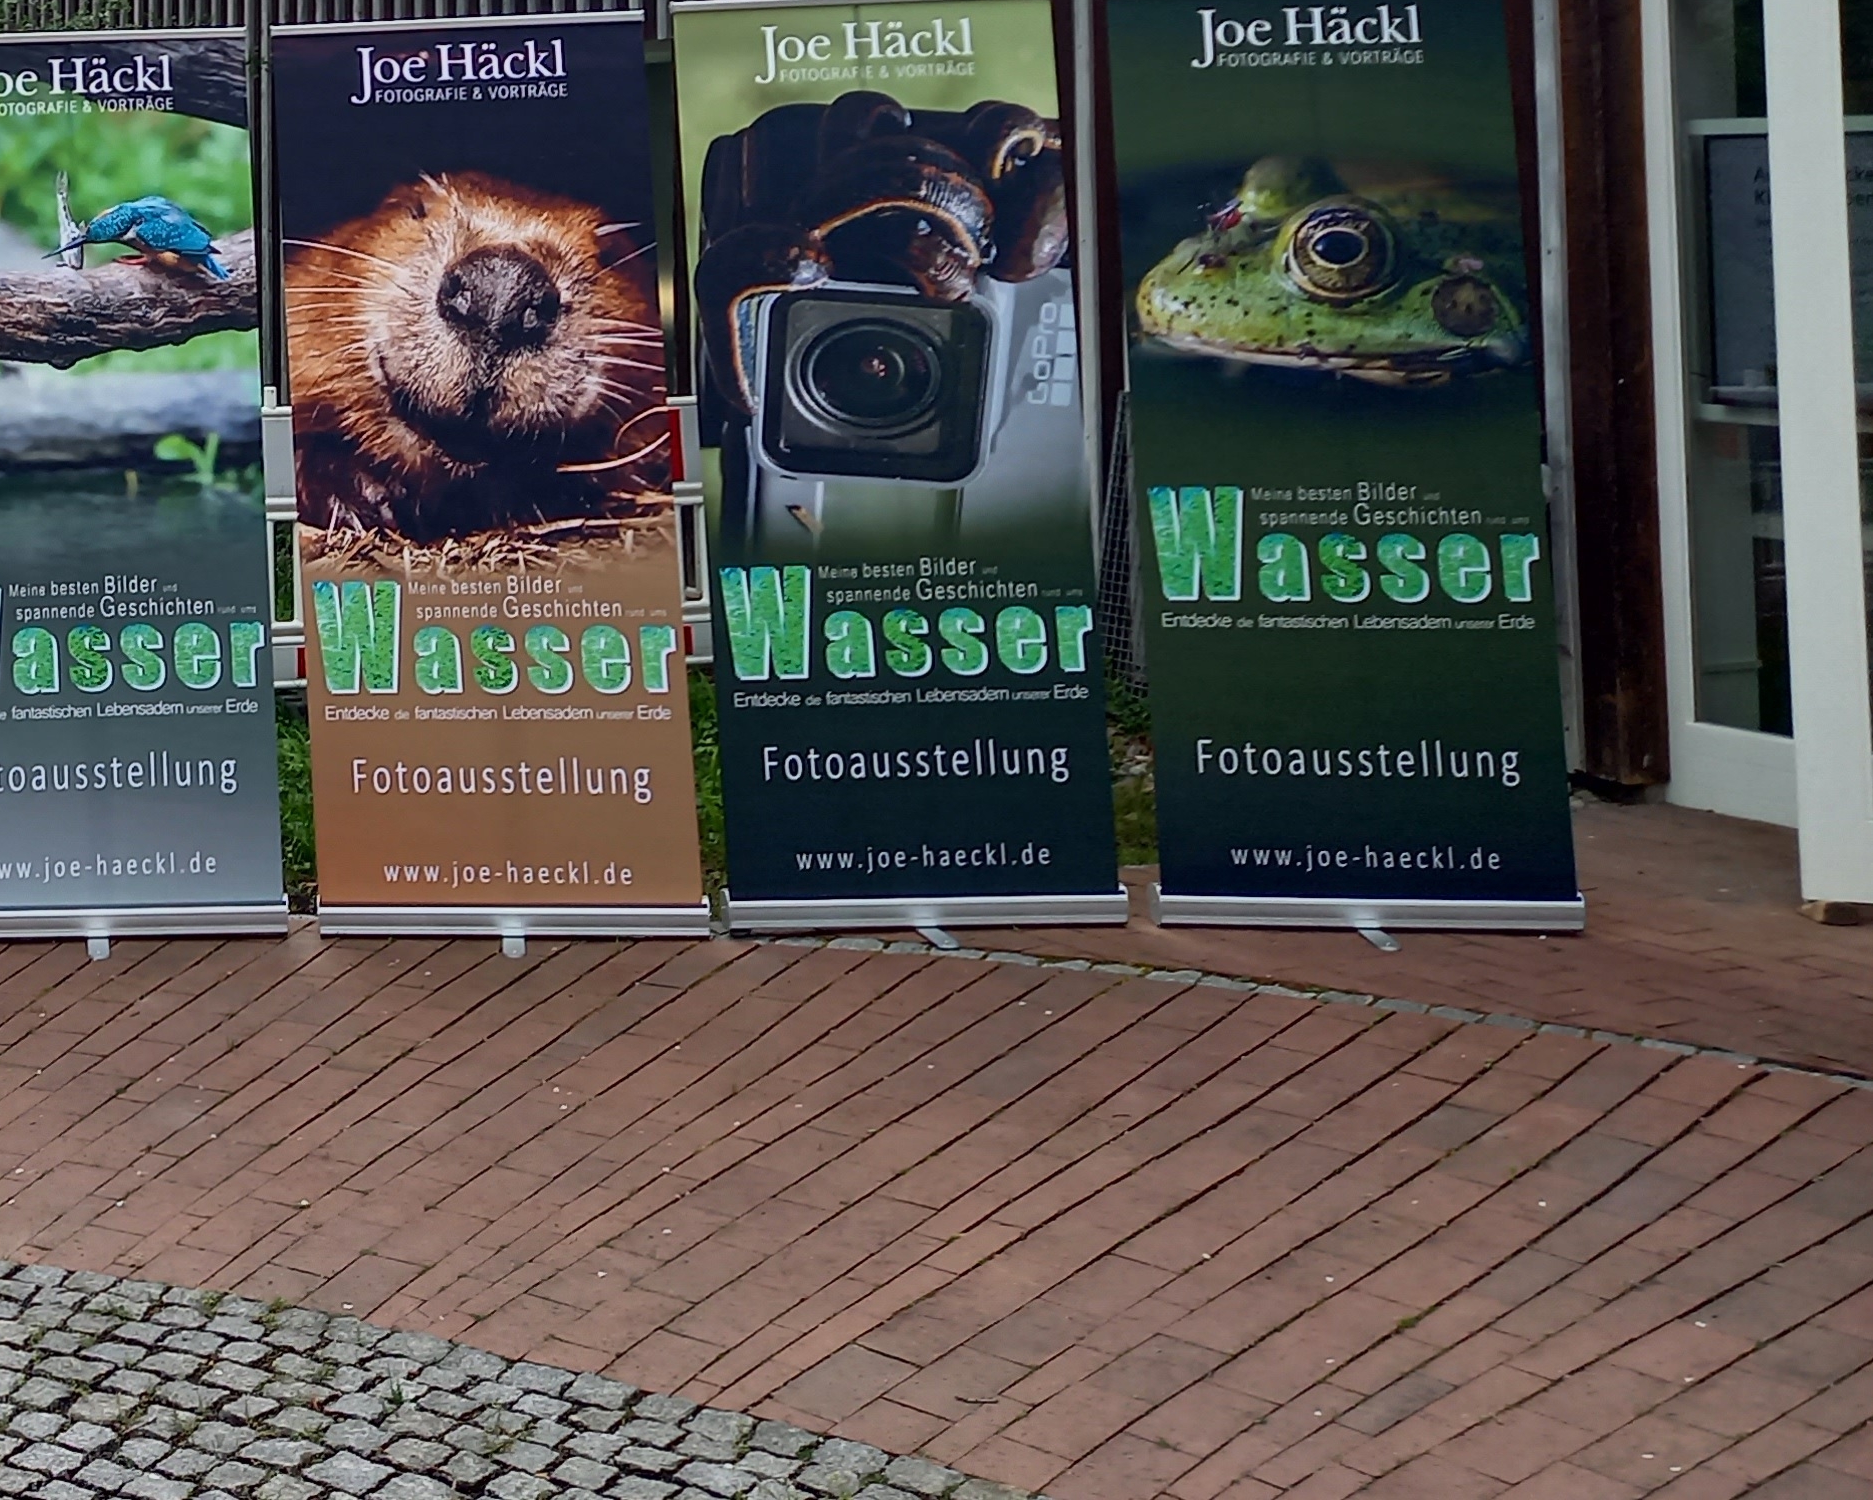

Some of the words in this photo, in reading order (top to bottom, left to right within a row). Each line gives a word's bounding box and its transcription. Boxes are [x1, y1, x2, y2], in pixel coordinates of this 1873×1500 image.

[1191, 9, 1272, 68] Joe
[1282, 4, 1423, 45] Häckl
[755, 26, 831, 84] Joe
[842, 18, 973, 60] Häckl
[1217, 52, 1316, 67] FOTOGRAFIE
[1321, 52, 1333, 65] &
[1338, 48, 1424, 65] VORTRÄGE
[48, 55, 173, 94] Häckl
[351, 47, 427, 104] Joe
[435, 39, 566, 81] Häckl
[880, 66, 889, 78] &
[896, 61, 975, 78] VORTRÄGE
[83, 101, 92, 112] &
[97, 95, 174, 112] VORTRÄGE
[376, 87, 467, 103] FOTOGRAFIE
[473, 88, 482, 99] &
[488, 81, 568, 99] VORTRÄGE
[1026, 301, 1057, 405] GoPro
[1298, 485, 1351, 501] besten
[1357, 482, 1416, 500] Bilder
[1260, 510, 1348, 527] spannende
[1353, 504, 1482, 525] Geschichten
[1148, 486, 1539, 602] Wasser
[862, 562, 915, 579] besten
[920, 557, 976, 576] Bilder
[9, 584, 45, 597] Meine
[51, 580, 99, 596] besten
[104, 575, 157, 594] Bilder
[409, 581, 445, 594] Meine
[451, 579, 501, 594] besten
[507, 576, 561, 594] Bilder
[827, 585, 911, 605] spannende
[916, 579, 1038, 600] Geschichten
[16, 602, 95, 622] spannende
[100, 596, 214, 618] Geschichten
[416, 603, 497, 620] spannende
[503, 596, 622, 618] Geschichten
[719, 564, 1093, 680] Wasser
[1162, 613, 1232, 628] Entdecke
[1498, 613, 1535, 630] Erde
[313, 580, 676, 695] Wasser
[734, 692, 801, 707] Entdecke
[1054, 684, 1089, 699] Erde
[12, 704, 91, 720] fantastischen
[97, 701, 184, 718] Lebensadern
[226, 698, 258, 714] Erde
[325, 706, 389, 721] Entdecke
[637, 706, 671, 721] Erde
[763, 739, 1069, 782] Fotoausstellung
[1197, 739, 1520, 787] Fotoausstellung
[352, 757, 652, 804] Fotoausstellung
[796, 842, 1051, 874] www.joe-haeckl.de
[1231, 845, 1501, 872] www.joe-haeckl.de
[384, 860, 632, 888] www.joe-haeckl.de
